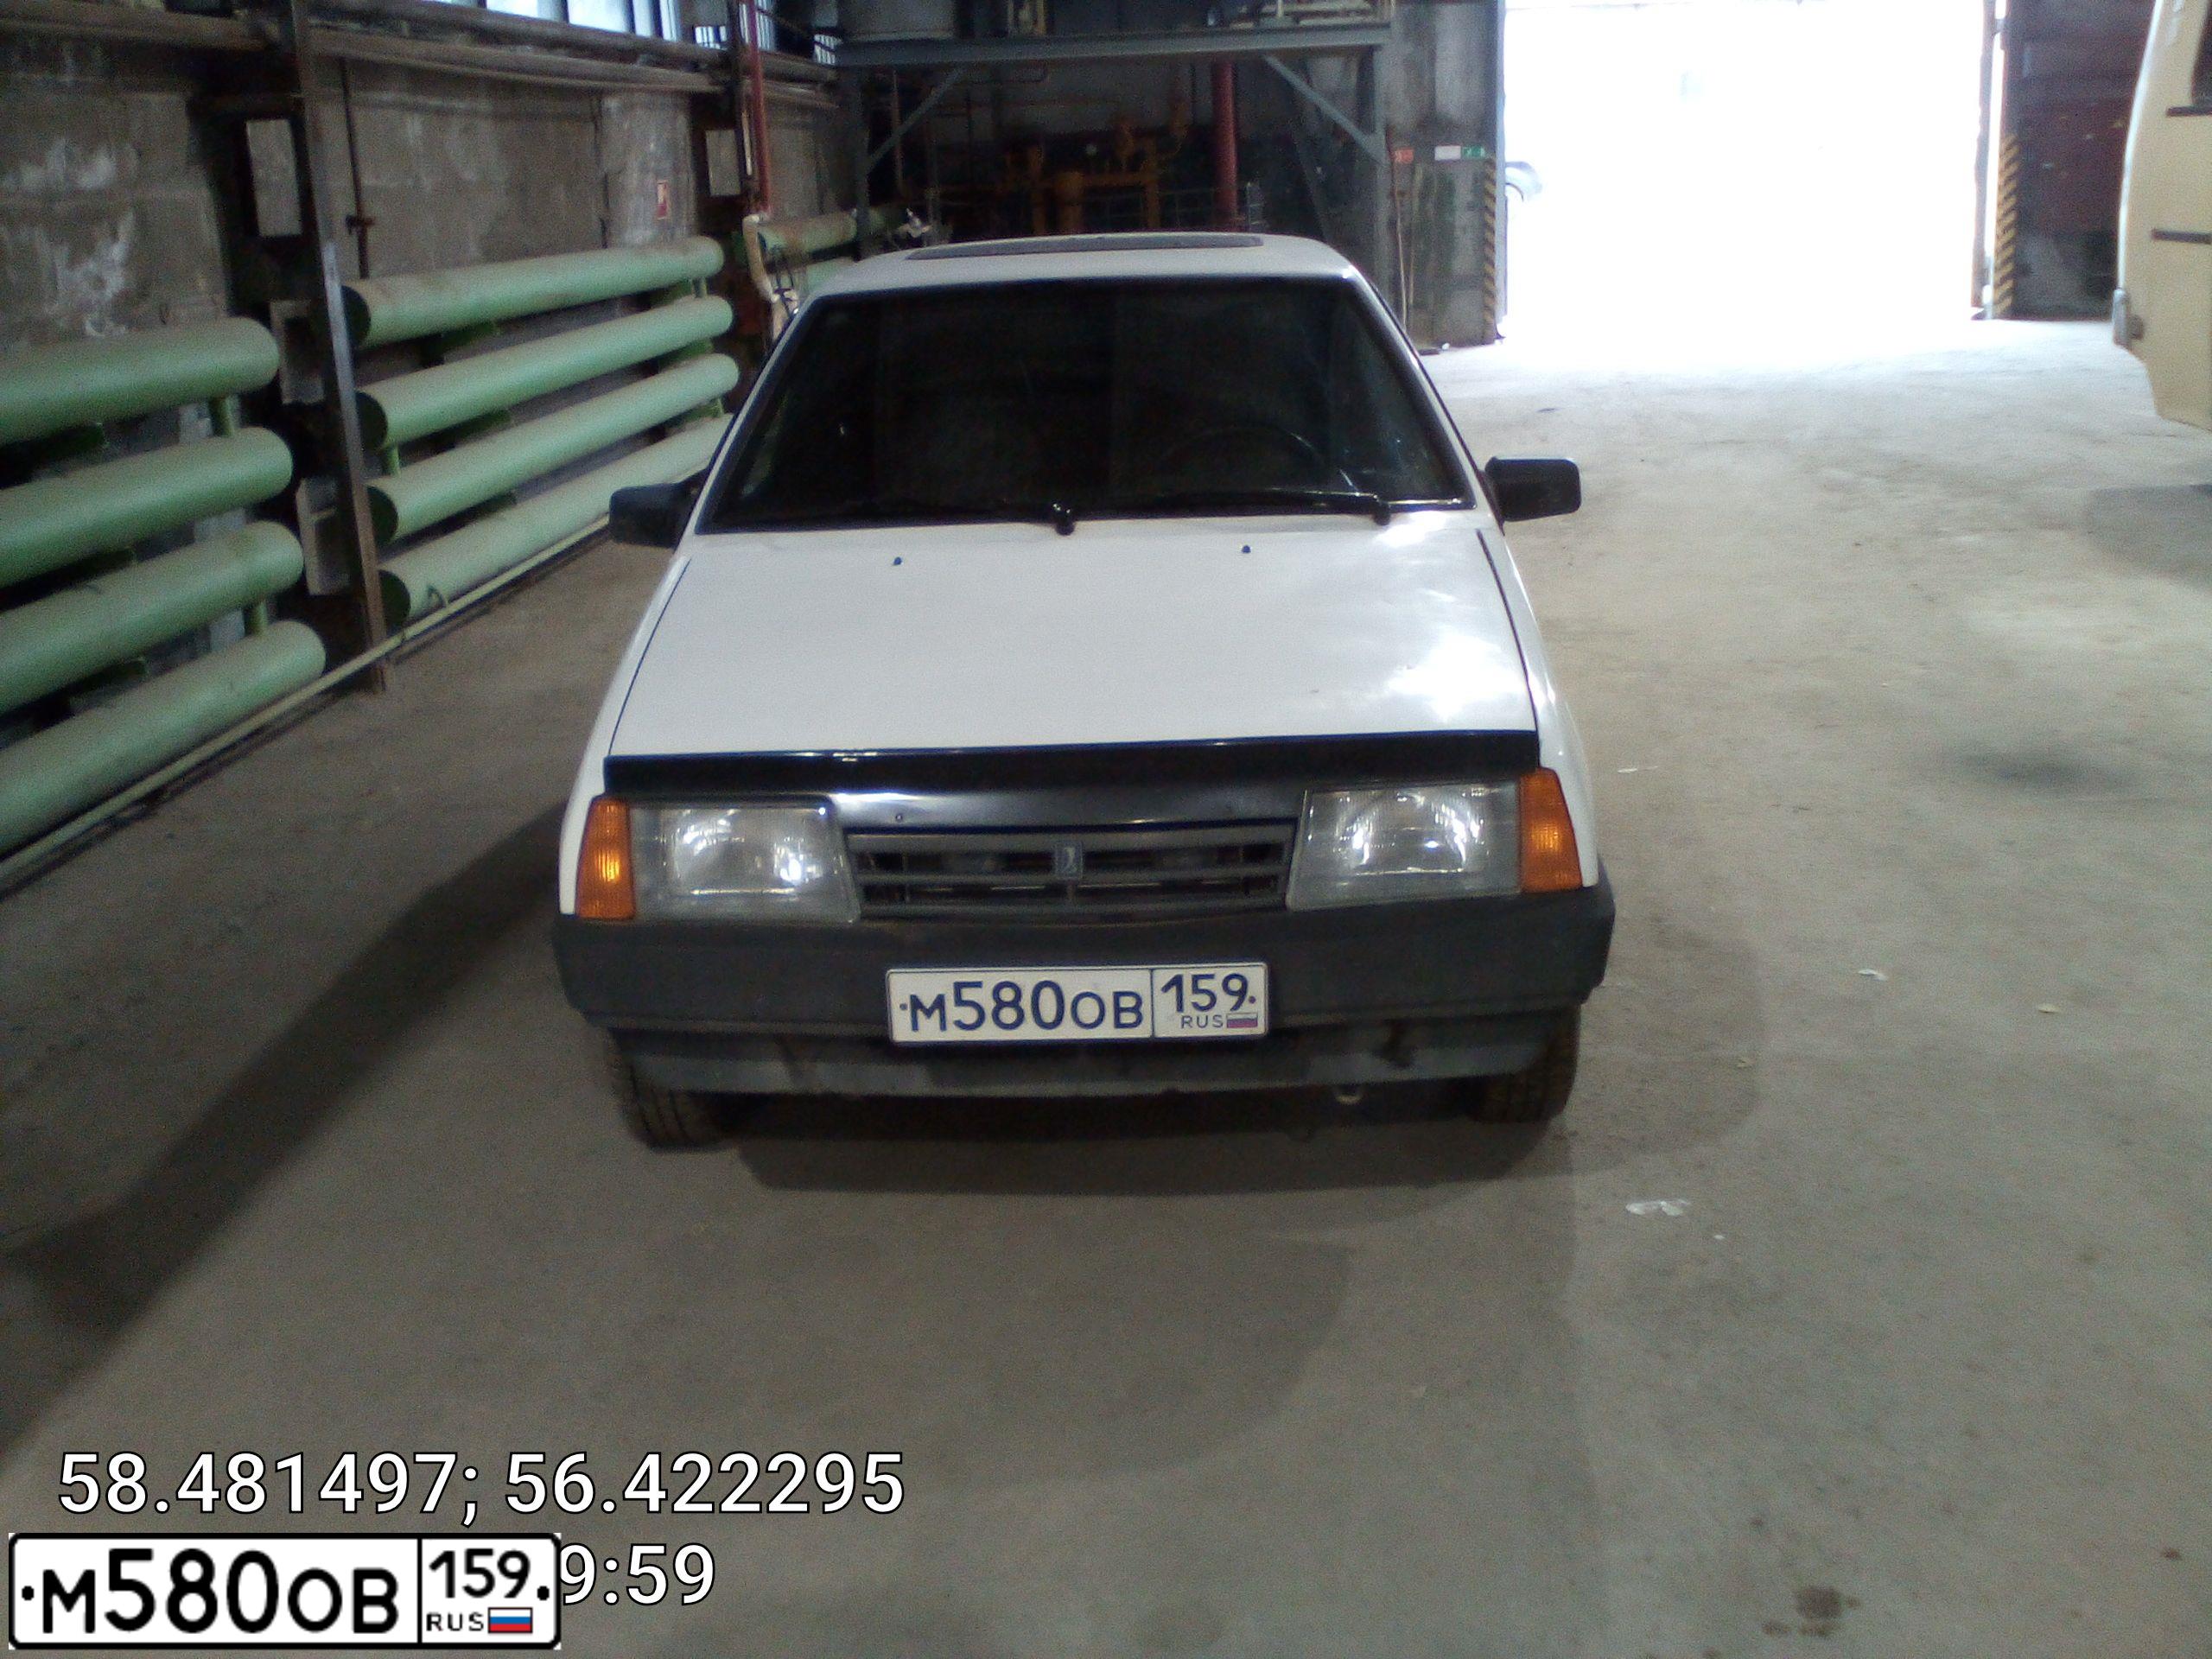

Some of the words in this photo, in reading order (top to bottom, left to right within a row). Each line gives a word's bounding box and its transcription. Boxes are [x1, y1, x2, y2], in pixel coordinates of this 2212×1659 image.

[910, 980, 1143, 1033] М580ОВ
[1160, 973, 1249, 1014] 159
[1180, 1014, 1224, 1029] RUS
